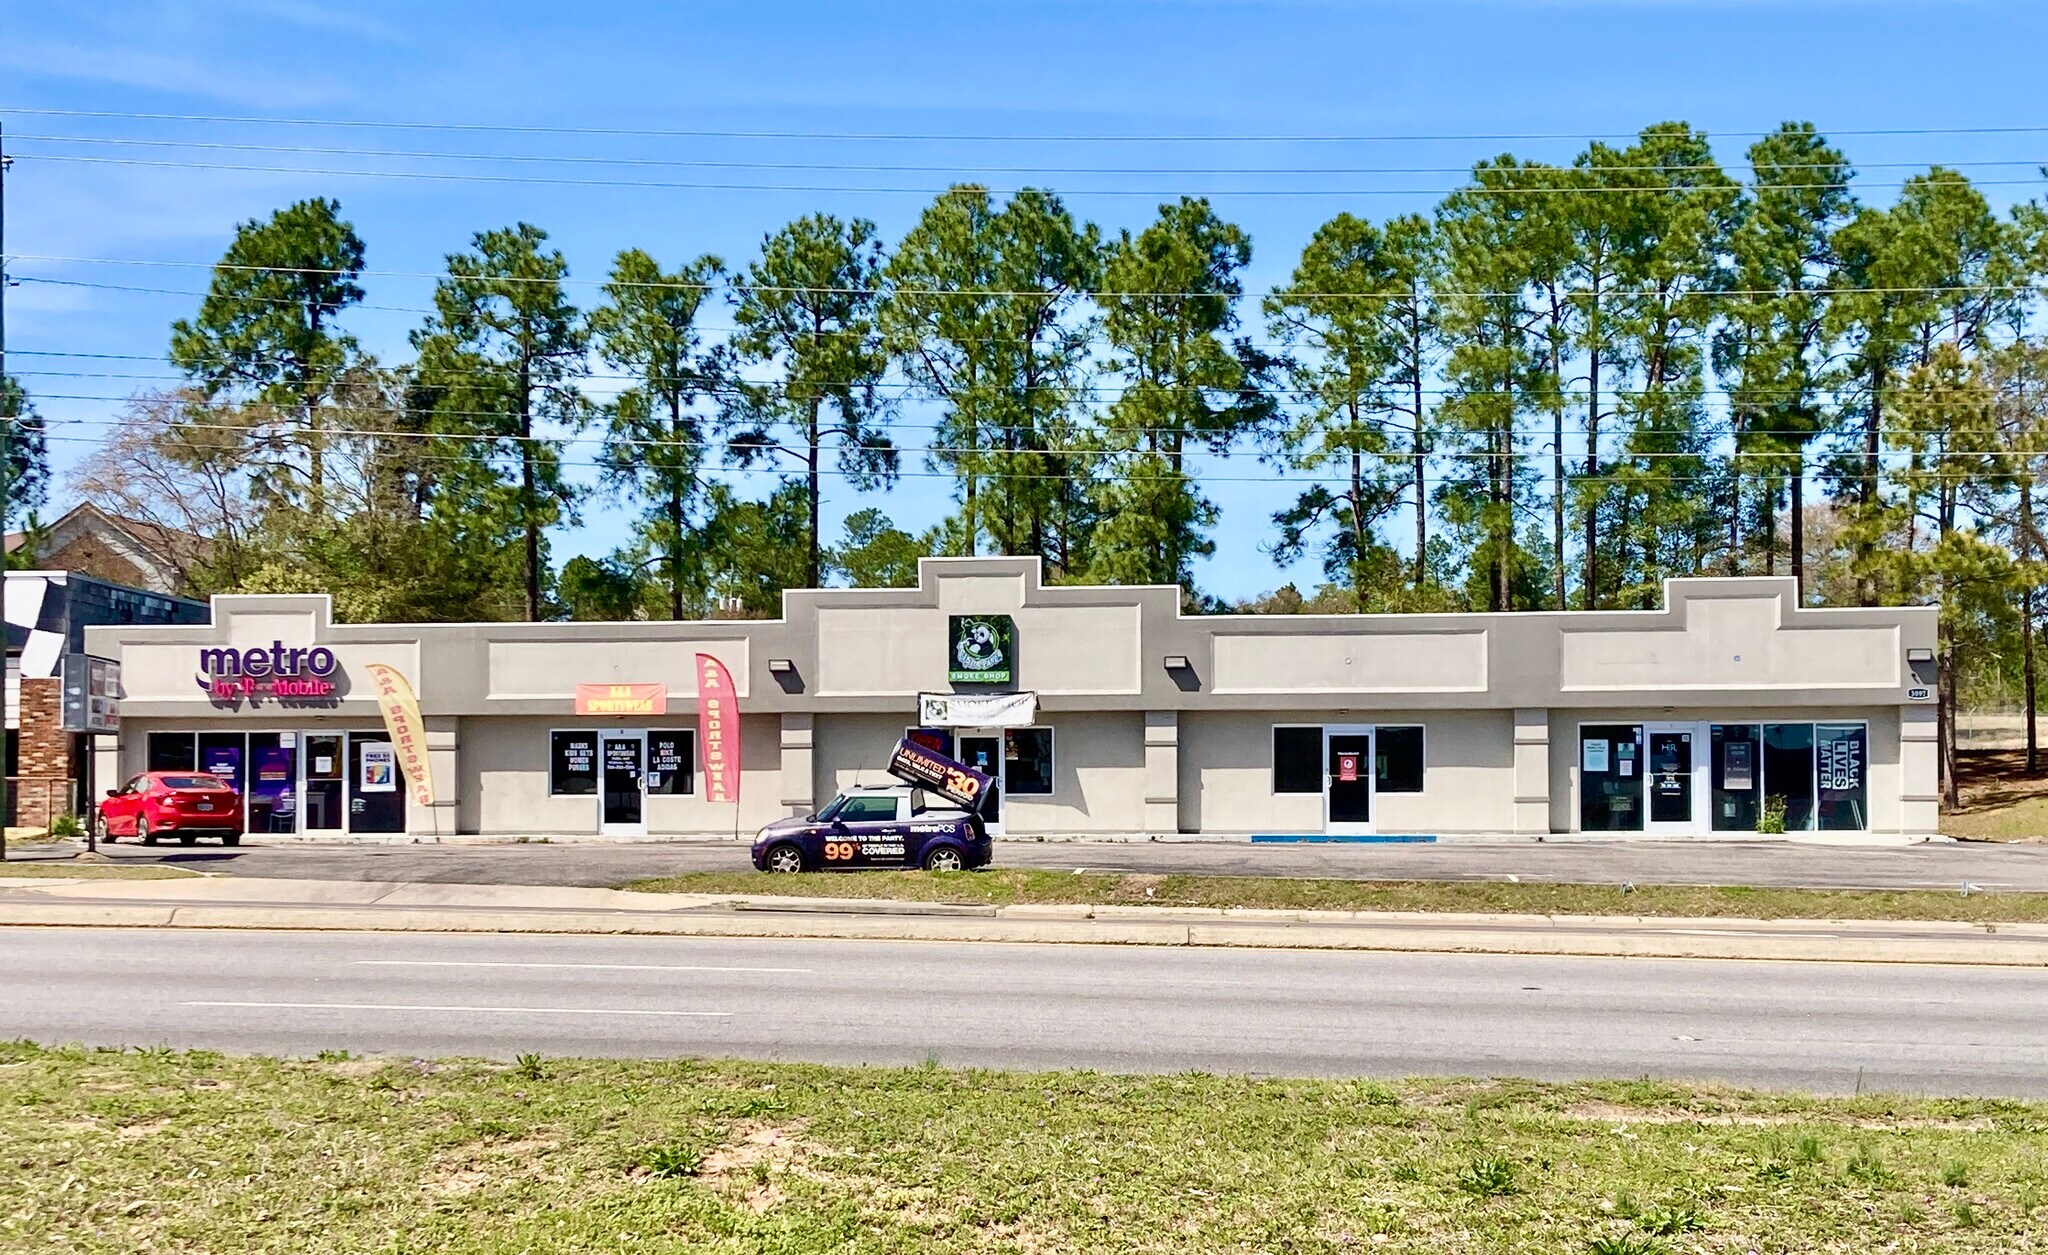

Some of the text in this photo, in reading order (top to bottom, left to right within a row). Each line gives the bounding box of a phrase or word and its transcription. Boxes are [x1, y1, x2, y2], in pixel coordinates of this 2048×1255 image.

[200, 640, 335, 676] metro
[213, 679, 234, 699] by
[587, 699, 653, 711] SPORTSWEAR
[899, 747, 946, 775] UNLIMITED
[1820, 740, 1832, 789] MATTER
[1833, 741, 1848, 788] LIVES
[1849, 740, 1860, 789] BLACK
[945, 784, 974, 801] PERIOD
[946, 766, 980, 796] $30
[910, 824, 956, 833] metroPCS
[862, 847, 905, 856] COVERED
